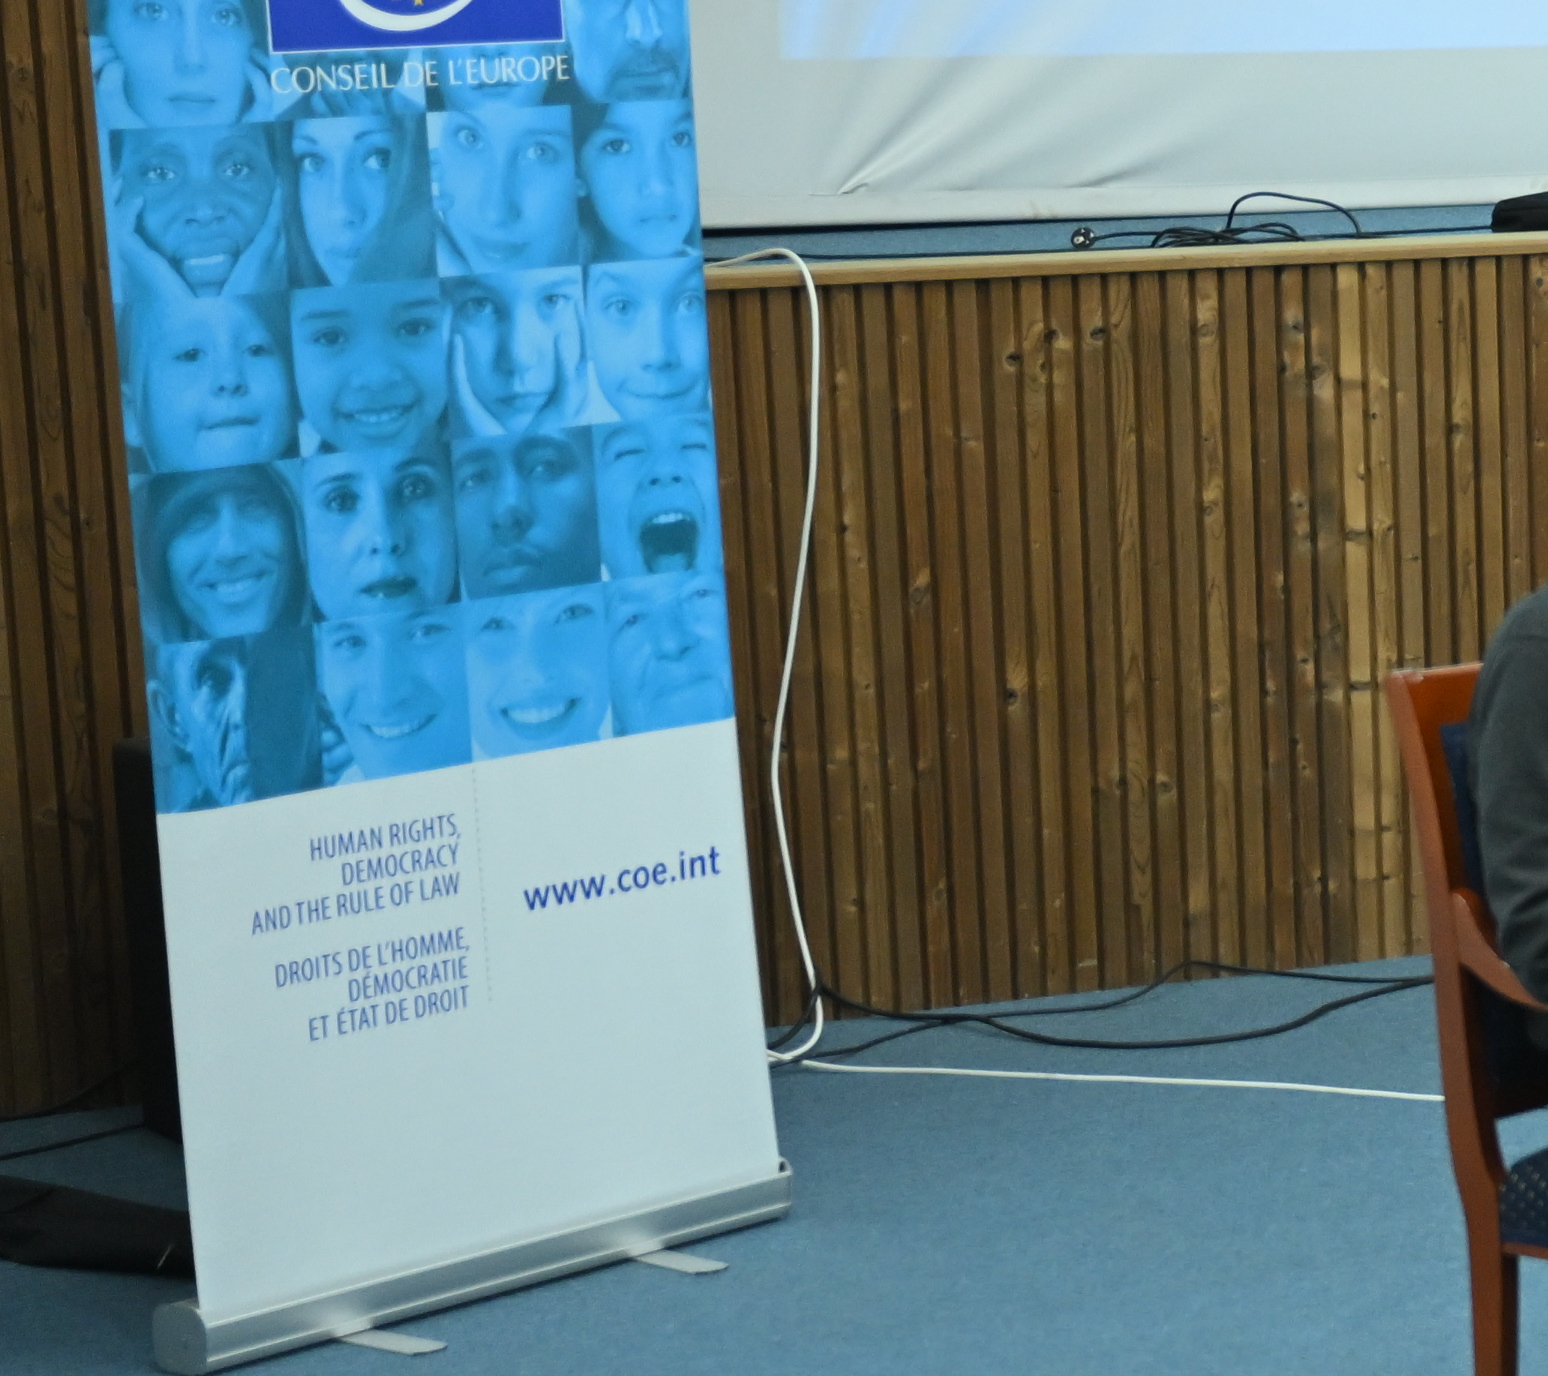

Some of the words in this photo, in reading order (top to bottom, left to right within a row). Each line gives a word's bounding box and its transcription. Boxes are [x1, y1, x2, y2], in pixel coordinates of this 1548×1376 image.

[269, 63, 396, 95] CONSEIL
[402, 61, 440, 88] DE
[447, 55, 571, 85] L'EUROPE
[309, 825, 384, 862] HUMAN
[389, 813, 462, 847] RIGHTS,
[341, 841, 460, 886] DEMOCRACY
[523, 845, 722, 912] www.coe.int
[251, 905, 292, 936] AND
[296, 896, 332, 926] THE
[336, 886, 386, 918] RULE
[390, 880, 415, 907] OF
[419, 871, 460, 902] LAW
[274, 951, 343, 989] DROITS
[347, 945, 373, 972] DE
[348, 955, 469, 1002] DÉMOCRATIE
[308, 1015, 330, 1042] ET
[336, 1004, 380, 1035] ÉTAT
[384, 998, 410, 1025] DE
[413, 984, 470, 1019] DROIT
